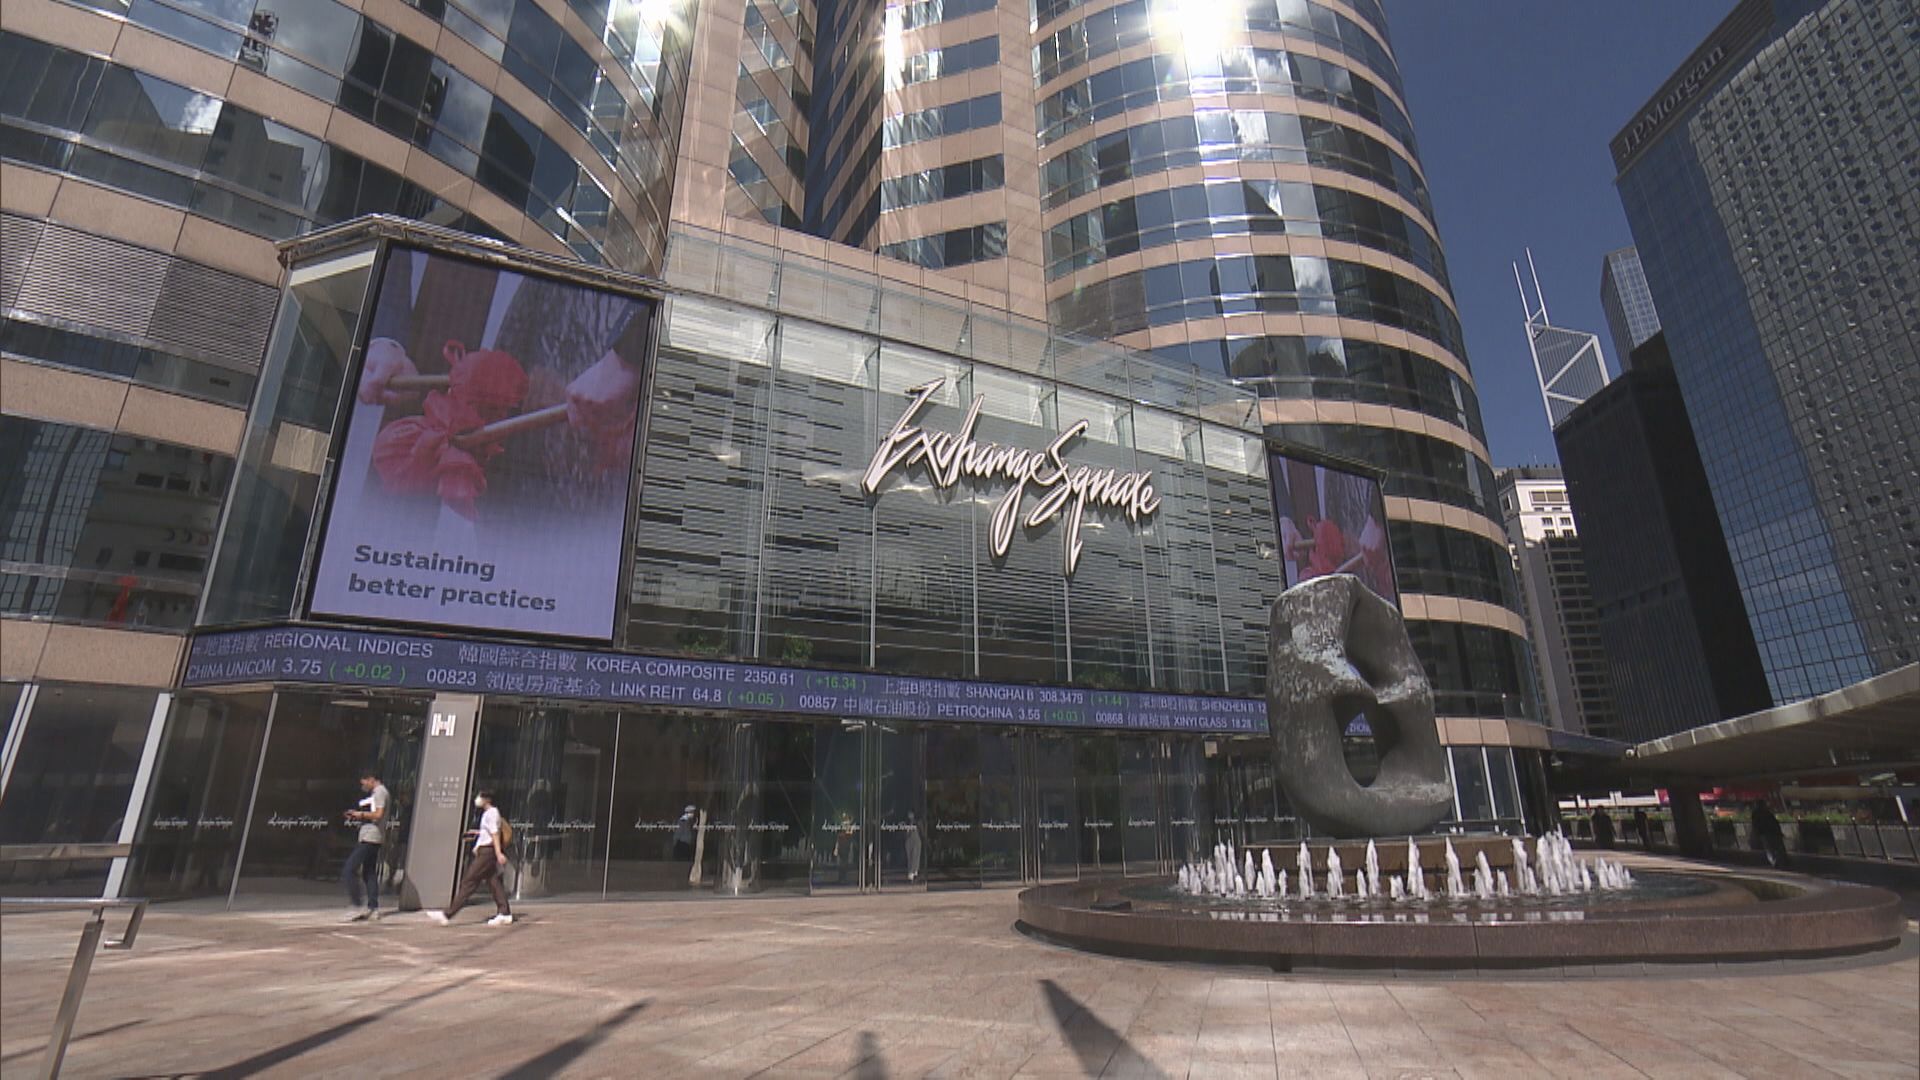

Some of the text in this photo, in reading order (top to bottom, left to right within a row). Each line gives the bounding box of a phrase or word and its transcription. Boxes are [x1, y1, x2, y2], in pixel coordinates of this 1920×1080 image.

[861, 376, 1161, 580] Exchange Square
[354, 544, 496, 582] Sustaining
[348, 573, 556, 612] better practices
[264, 632, 433, 658] REGIONAL INDICES
[458, 644, 577, 672] 韓國綜合指數
[187, 663, 223, 679] CHINA
[225, 658, 276, 676] UNICOM
[282, 657, 322, 675] 3.75
[426, 668, 477, 686] 00823
[485, 671, 602, 696] 領展房產基金
[586, 657, 642, 674] KOREA
[646, 661, 736, 682] COMPOSITE
[744, 668, 795, 686] 2350.61
[611, 681, 646, 697] LINK
[650, 685, 685, 700] REIT
[693, 688, 722, 702] 64.8
[800, 695, 837, 709] 00857
[965, 686, 1025, 701] SHANGHAI
[1027, 690, 1034, 701] B
[937, 703, 1013, 718] PETROCHINA
[1173, 716, 1197, 728] XINYI
[1199, 717, 1228, 729] GLASS
